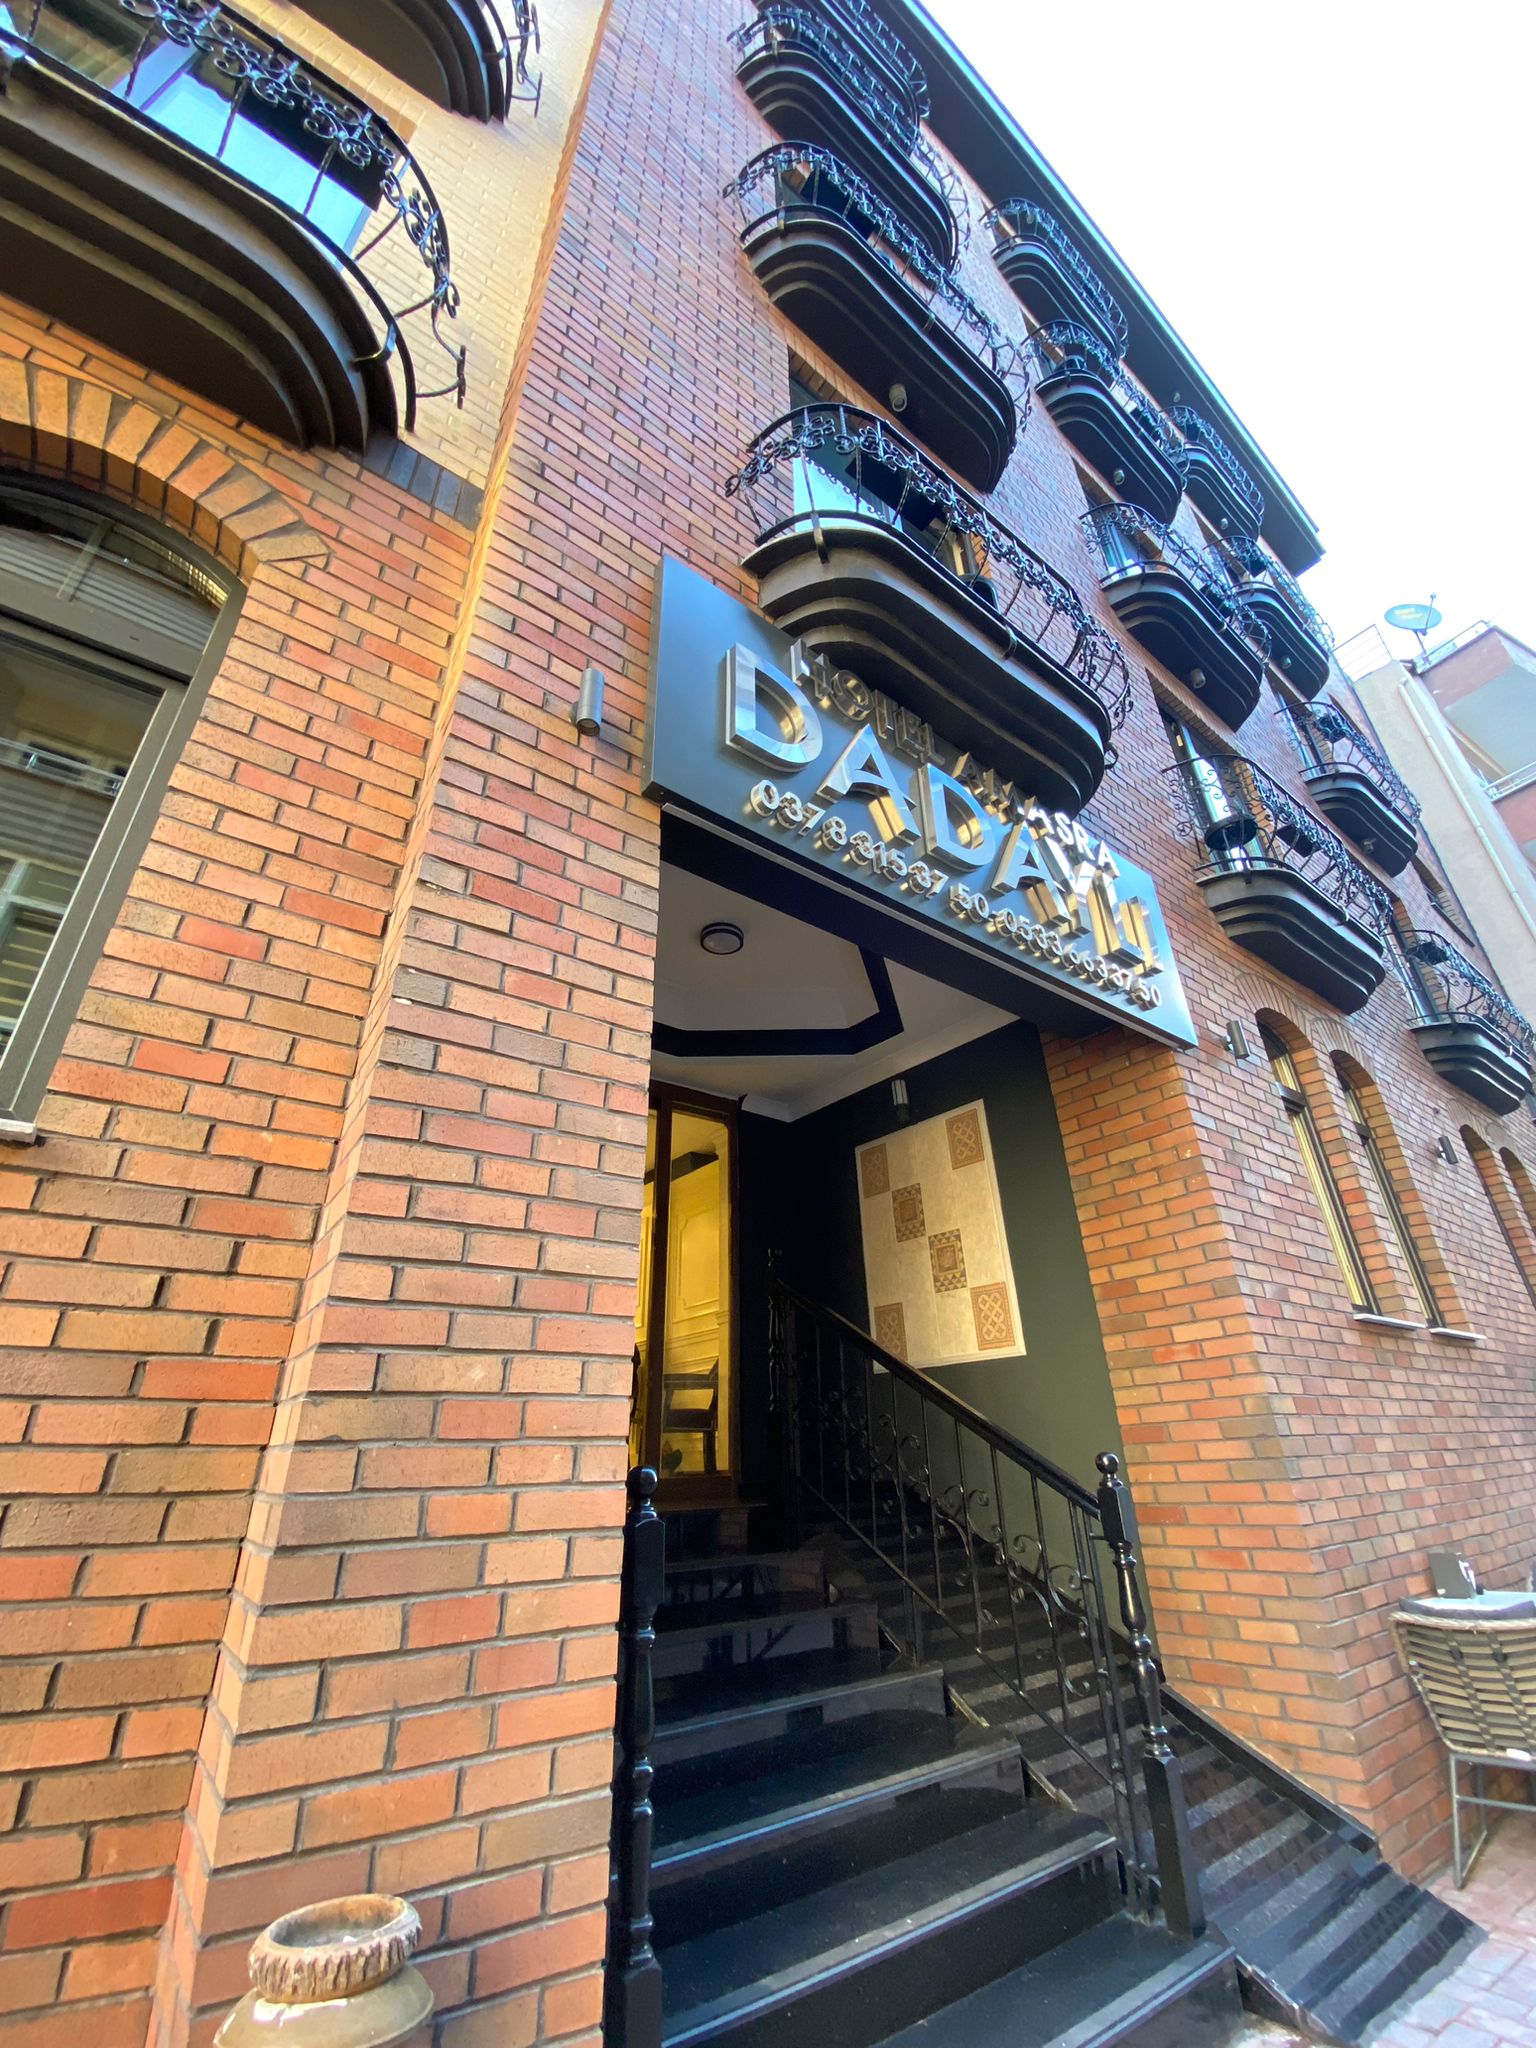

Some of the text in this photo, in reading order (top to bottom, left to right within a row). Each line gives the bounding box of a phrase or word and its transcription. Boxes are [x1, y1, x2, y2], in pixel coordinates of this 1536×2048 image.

[726, 642, 1165, 976] DADAYLI
[791, 638, 1120, 878] HOTEL AMASRA
